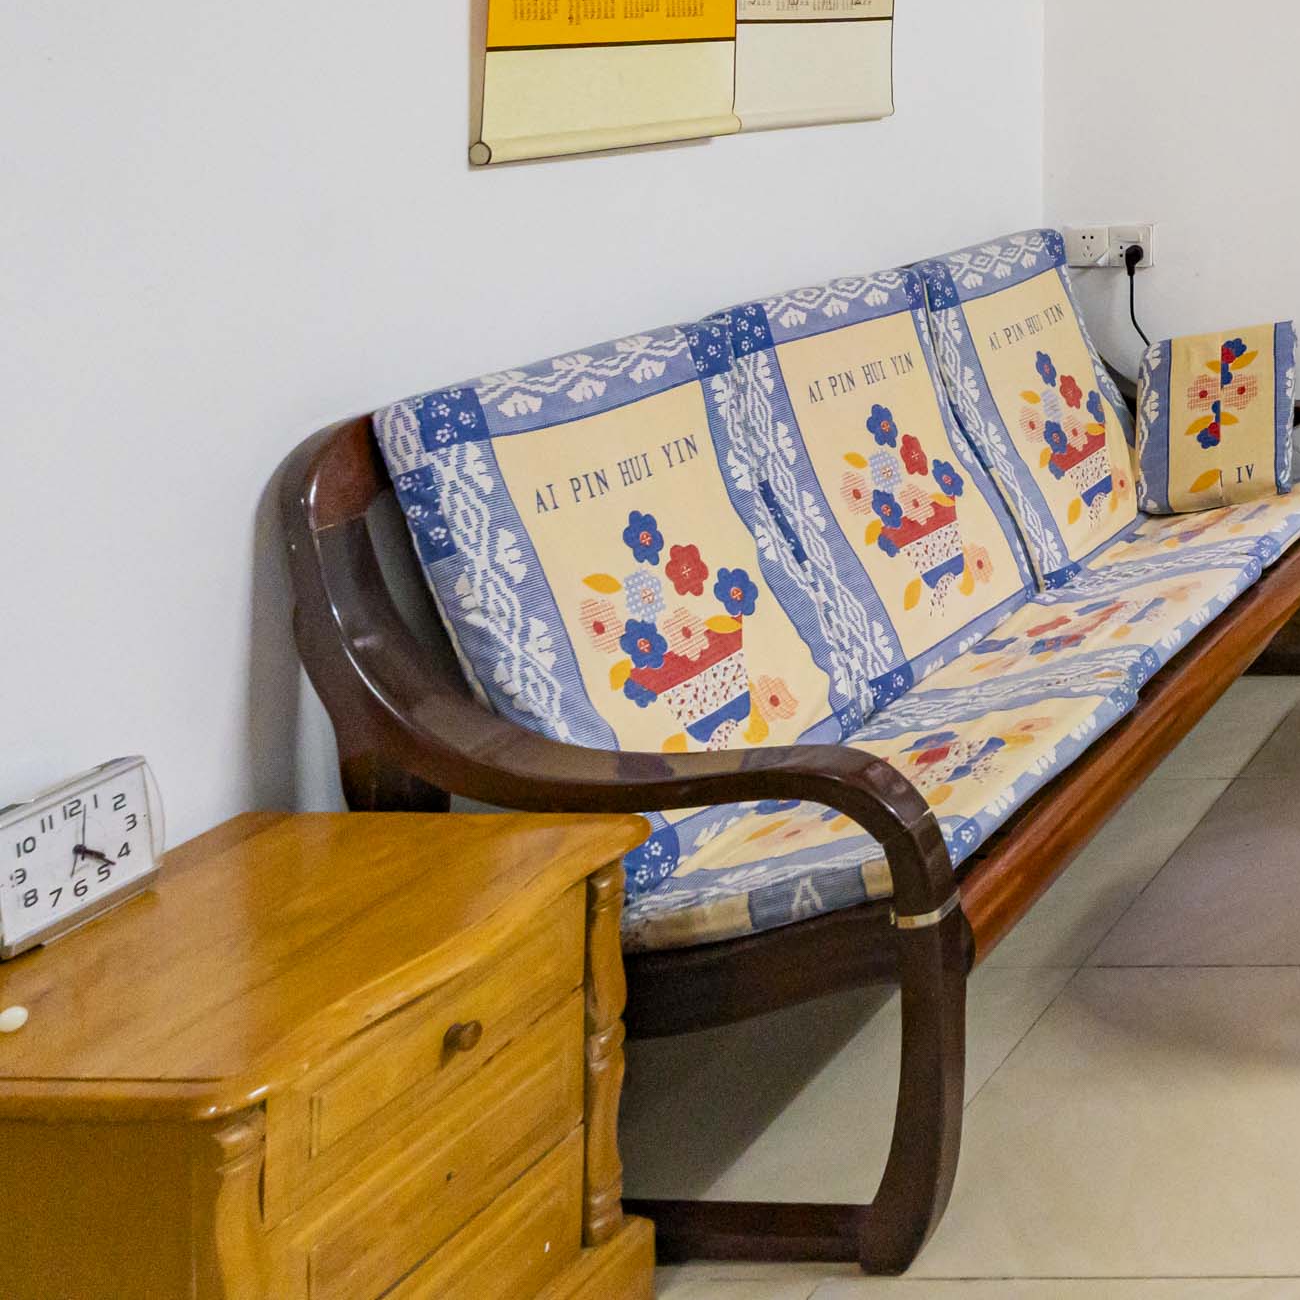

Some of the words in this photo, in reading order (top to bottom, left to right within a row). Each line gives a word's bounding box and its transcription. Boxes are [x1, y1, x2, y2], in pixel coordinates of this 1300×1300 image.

[1003, 322, 1024, 345] PIN
[1044, 303, 1064, 326] YIN
[808, 380, 824, 404] AI
[828, 370, 856, 396] PIN
[861, 360, 886, 385] HUI
[890, 352, 914, 376] YIN
[535, 483, 559, 514] AI
[568, 468, 611, 503] PIN
[617, 452, 653, 487] HUI
[661, 434, 699, 468] YIN
[63, 799, 82, 820] 12
[94, 794, 98, 809] 1
[112, 793, 127, 811] 2
[40, 814, 54, 834] 11
[125, 814, 137, 832] 3
[16, 836, 36, 858] 10
[117, 842, 132, 858] 4
[97, 864, 111, 882] 5
[24, 888, 38, 908] 8
[50, 887, 63, 908] 7
[74, 879, 88, 897] 6
